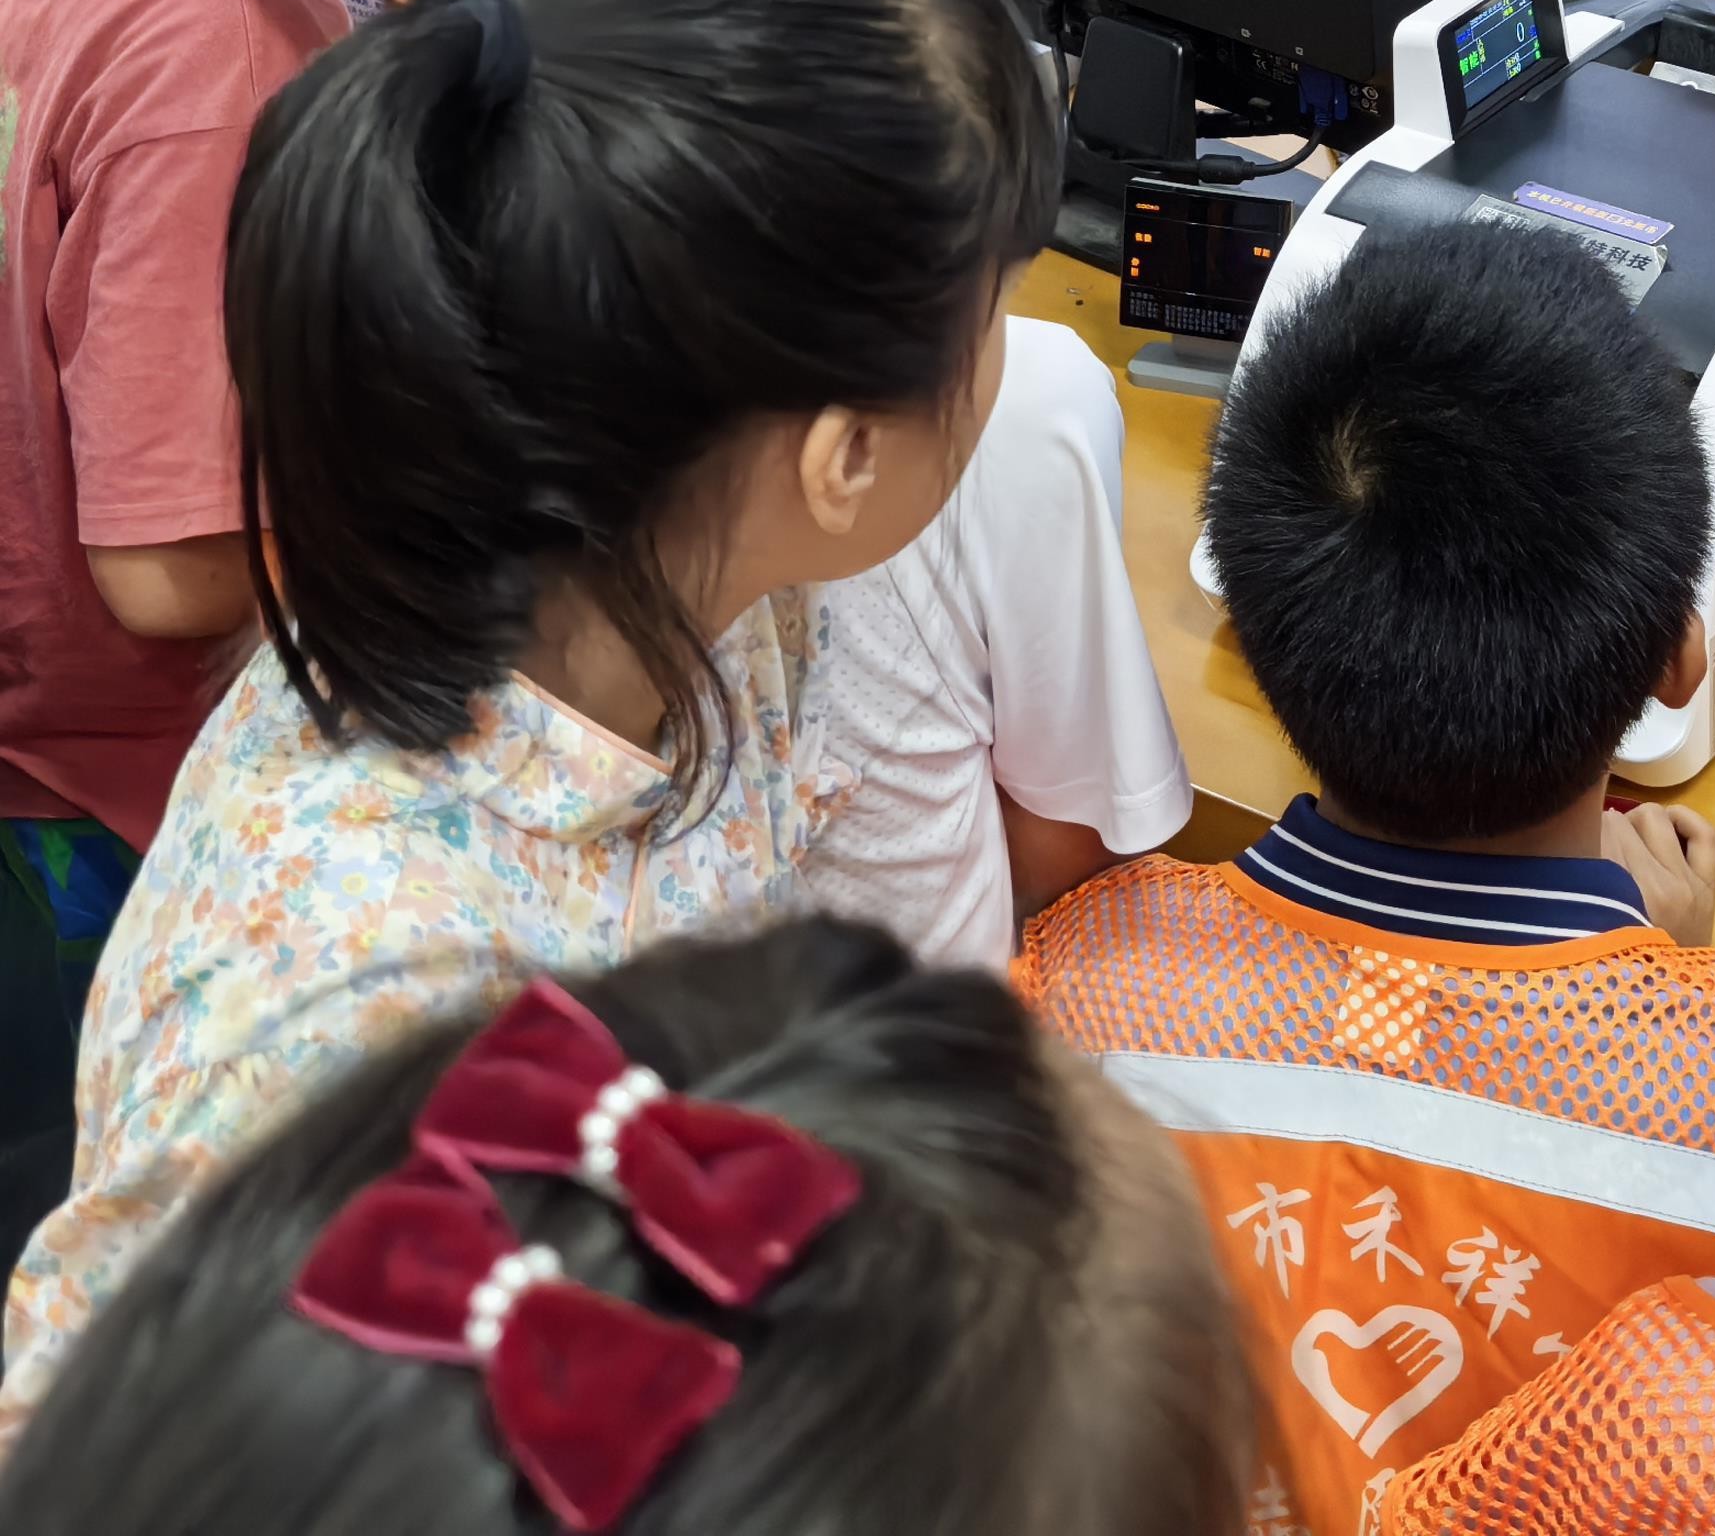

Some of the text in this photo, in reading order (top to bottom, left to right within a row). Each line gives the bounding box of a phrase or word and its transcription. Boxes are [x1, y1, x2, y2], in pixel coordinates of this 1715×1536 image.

[1574, 232, 1652, 271] 特科技
[1226, 1180, 1573, 1357] 市禾祥
